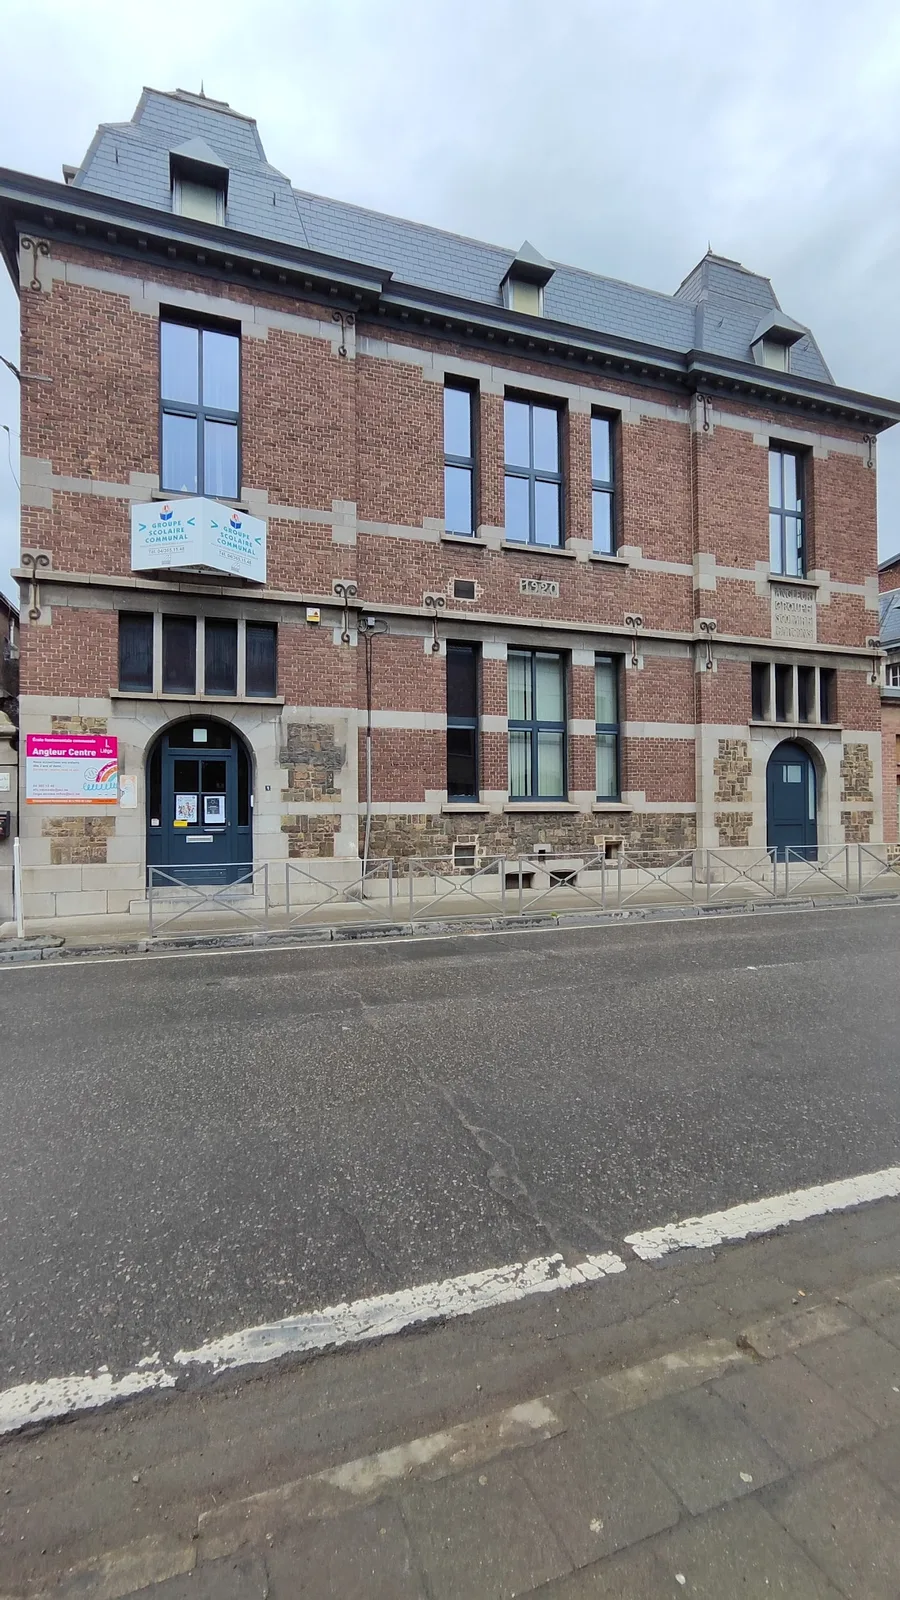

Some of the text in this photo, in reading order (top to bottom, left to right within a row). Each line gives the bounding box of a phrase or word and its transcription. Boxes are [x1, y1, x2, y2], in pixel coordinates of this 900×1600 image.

[152, 520, 181, 529] GROUPE
[149, 527, 184, 536] SCOLAIRE
[223, 526, 250, 540] GROUPE
[145, 534, 188, 543] COMMUNAL
[220, 532, 252, 548] SCOLAIRE
[217, 538, 255, 555] COMMUNAL
[521, 580, 558, 596] 1920
[774, 600, 813, 613] GROUPE
[32, 748, 97, 757] Angleur Centre
